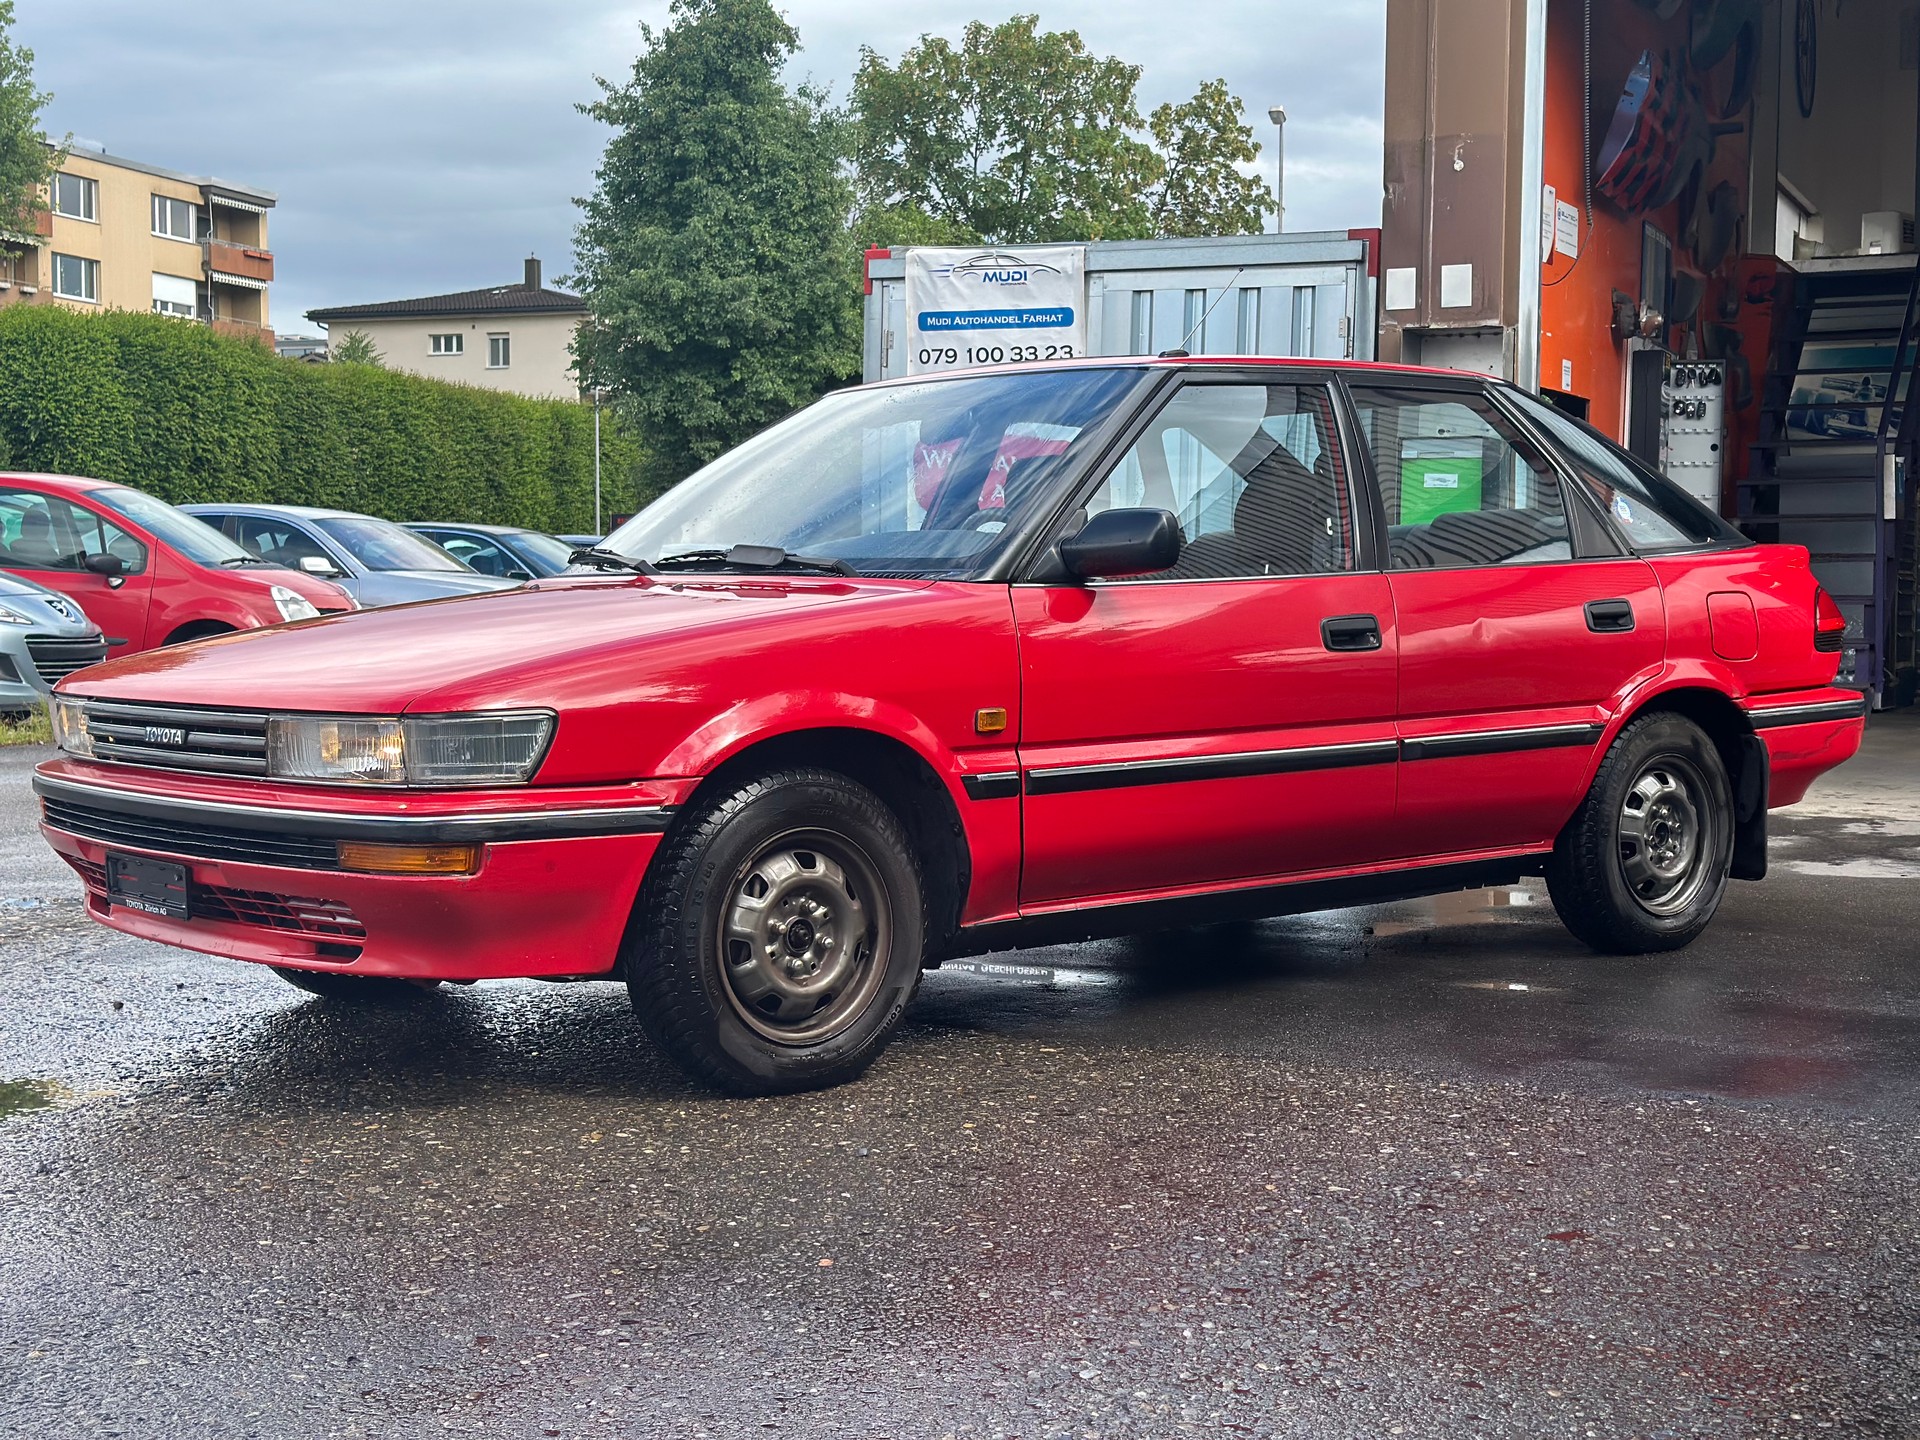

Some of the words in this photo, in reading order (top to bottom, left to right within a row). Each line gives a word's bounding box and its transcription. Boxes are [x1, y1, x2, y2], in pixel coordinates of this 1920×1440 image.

[983, 271, 1027, 282] MUDI
[918, 348, 958, 365] 079
[966, 347, 1004, 364] 100
[1010, 346, 1038, 362] 33
[1045, 345, 1074, 360] 23
[145, 726, 182, 744] TOYOTA
[126, 899, 144, 910] TOYOTA
[159, 907, 167, 915] AG
